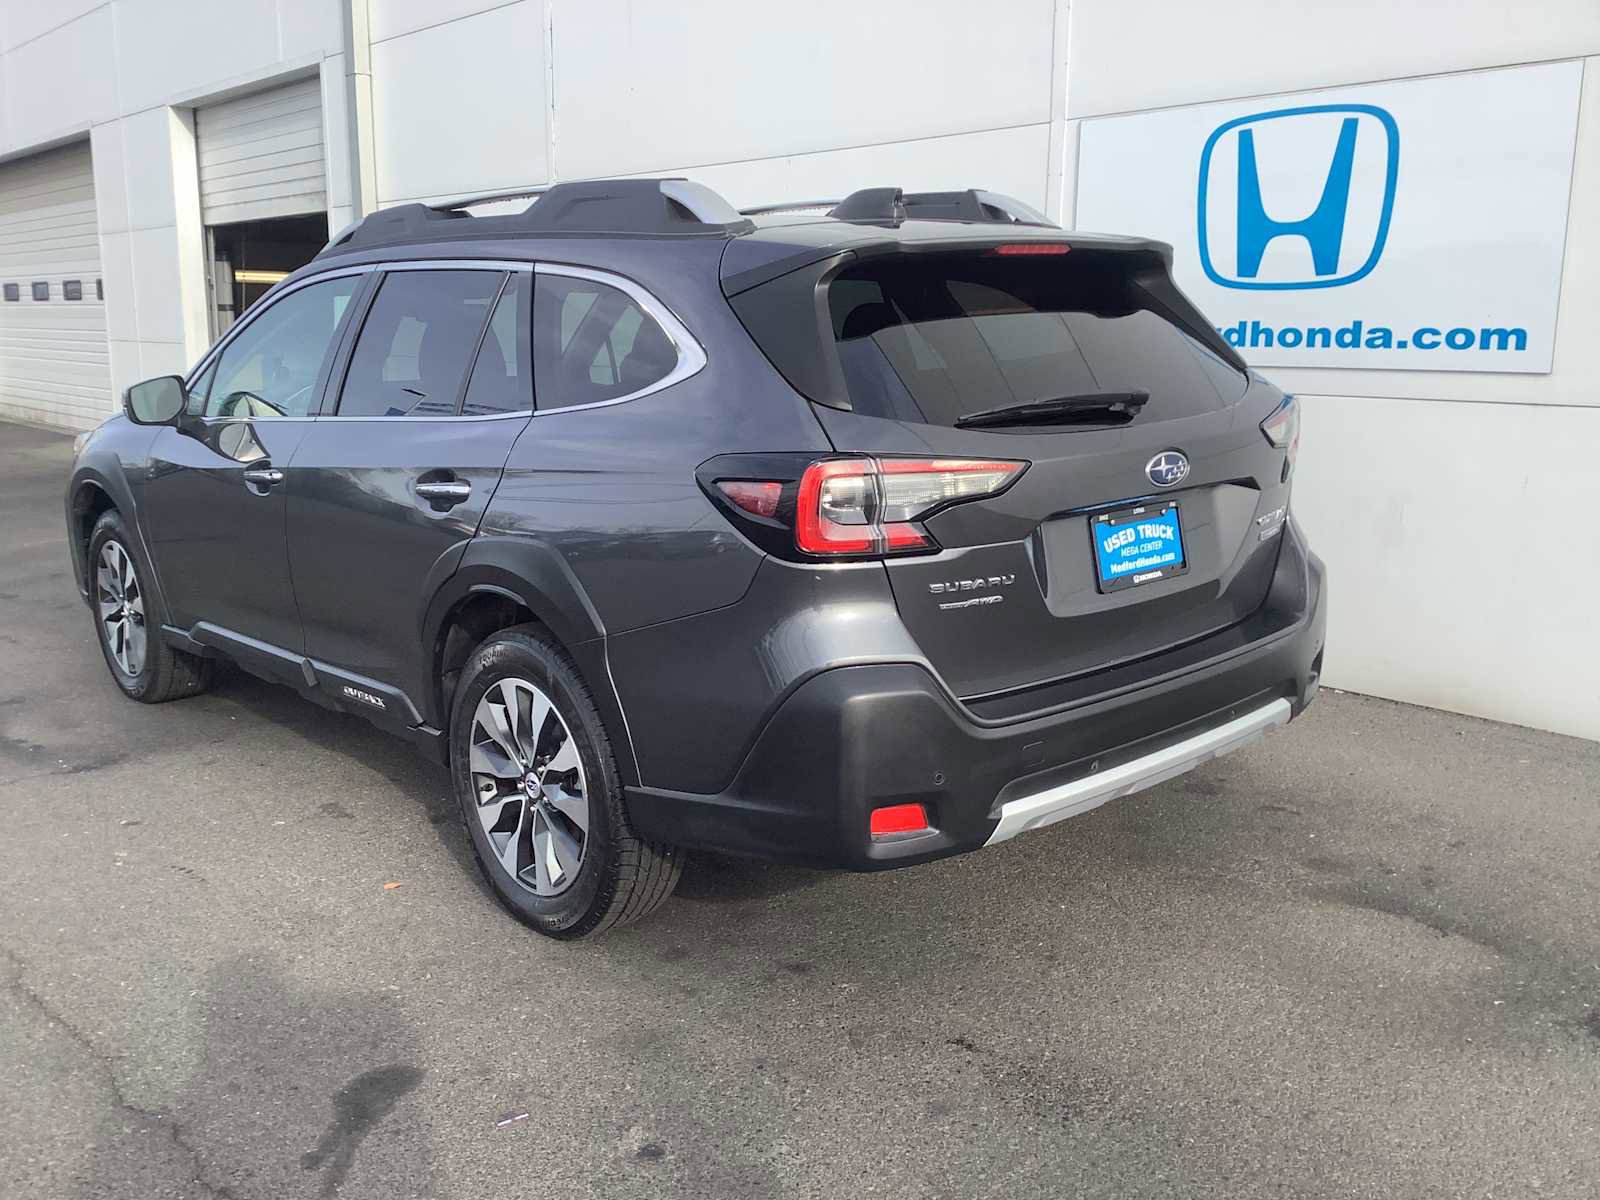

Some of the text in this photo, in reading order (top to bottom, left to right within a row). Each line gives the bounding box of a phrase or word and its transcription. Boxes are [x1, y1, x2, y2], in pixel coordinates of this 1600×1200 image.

[1216, 320, 1527, 351] dhonda.com
[1103, 524, 1174, 553] USED TRUCK
[1121, 540, 1162, 557] MEGA CENTER
[929, 574, 1015, 593] SUBARU
